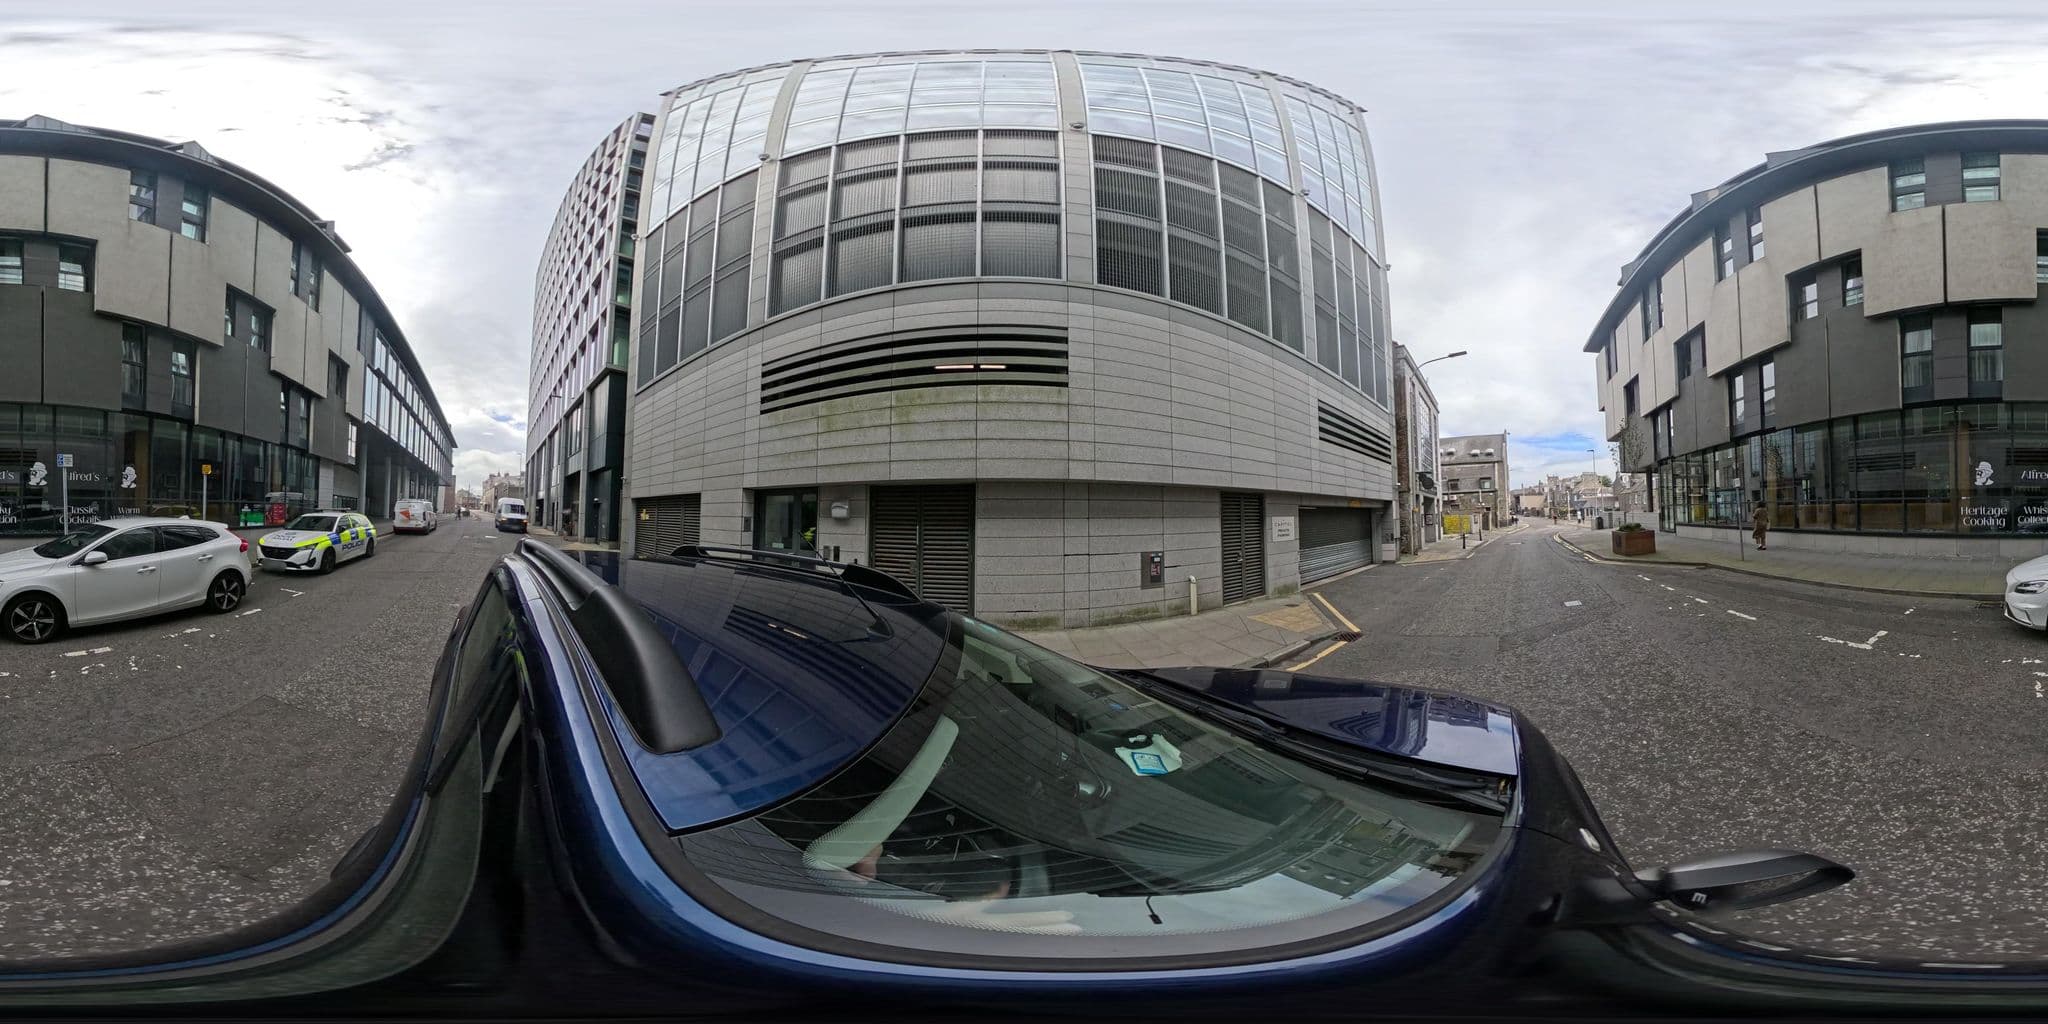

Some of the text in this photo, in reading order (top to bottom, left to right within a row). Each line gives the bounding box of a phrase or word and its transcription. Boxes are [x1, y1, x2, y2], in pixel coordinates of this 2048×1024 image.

[1961, 505, 2008, 518] Heritage
[1962, 516, 2006, 529] Cooking
[342, 540, 365, 551] POLICE
